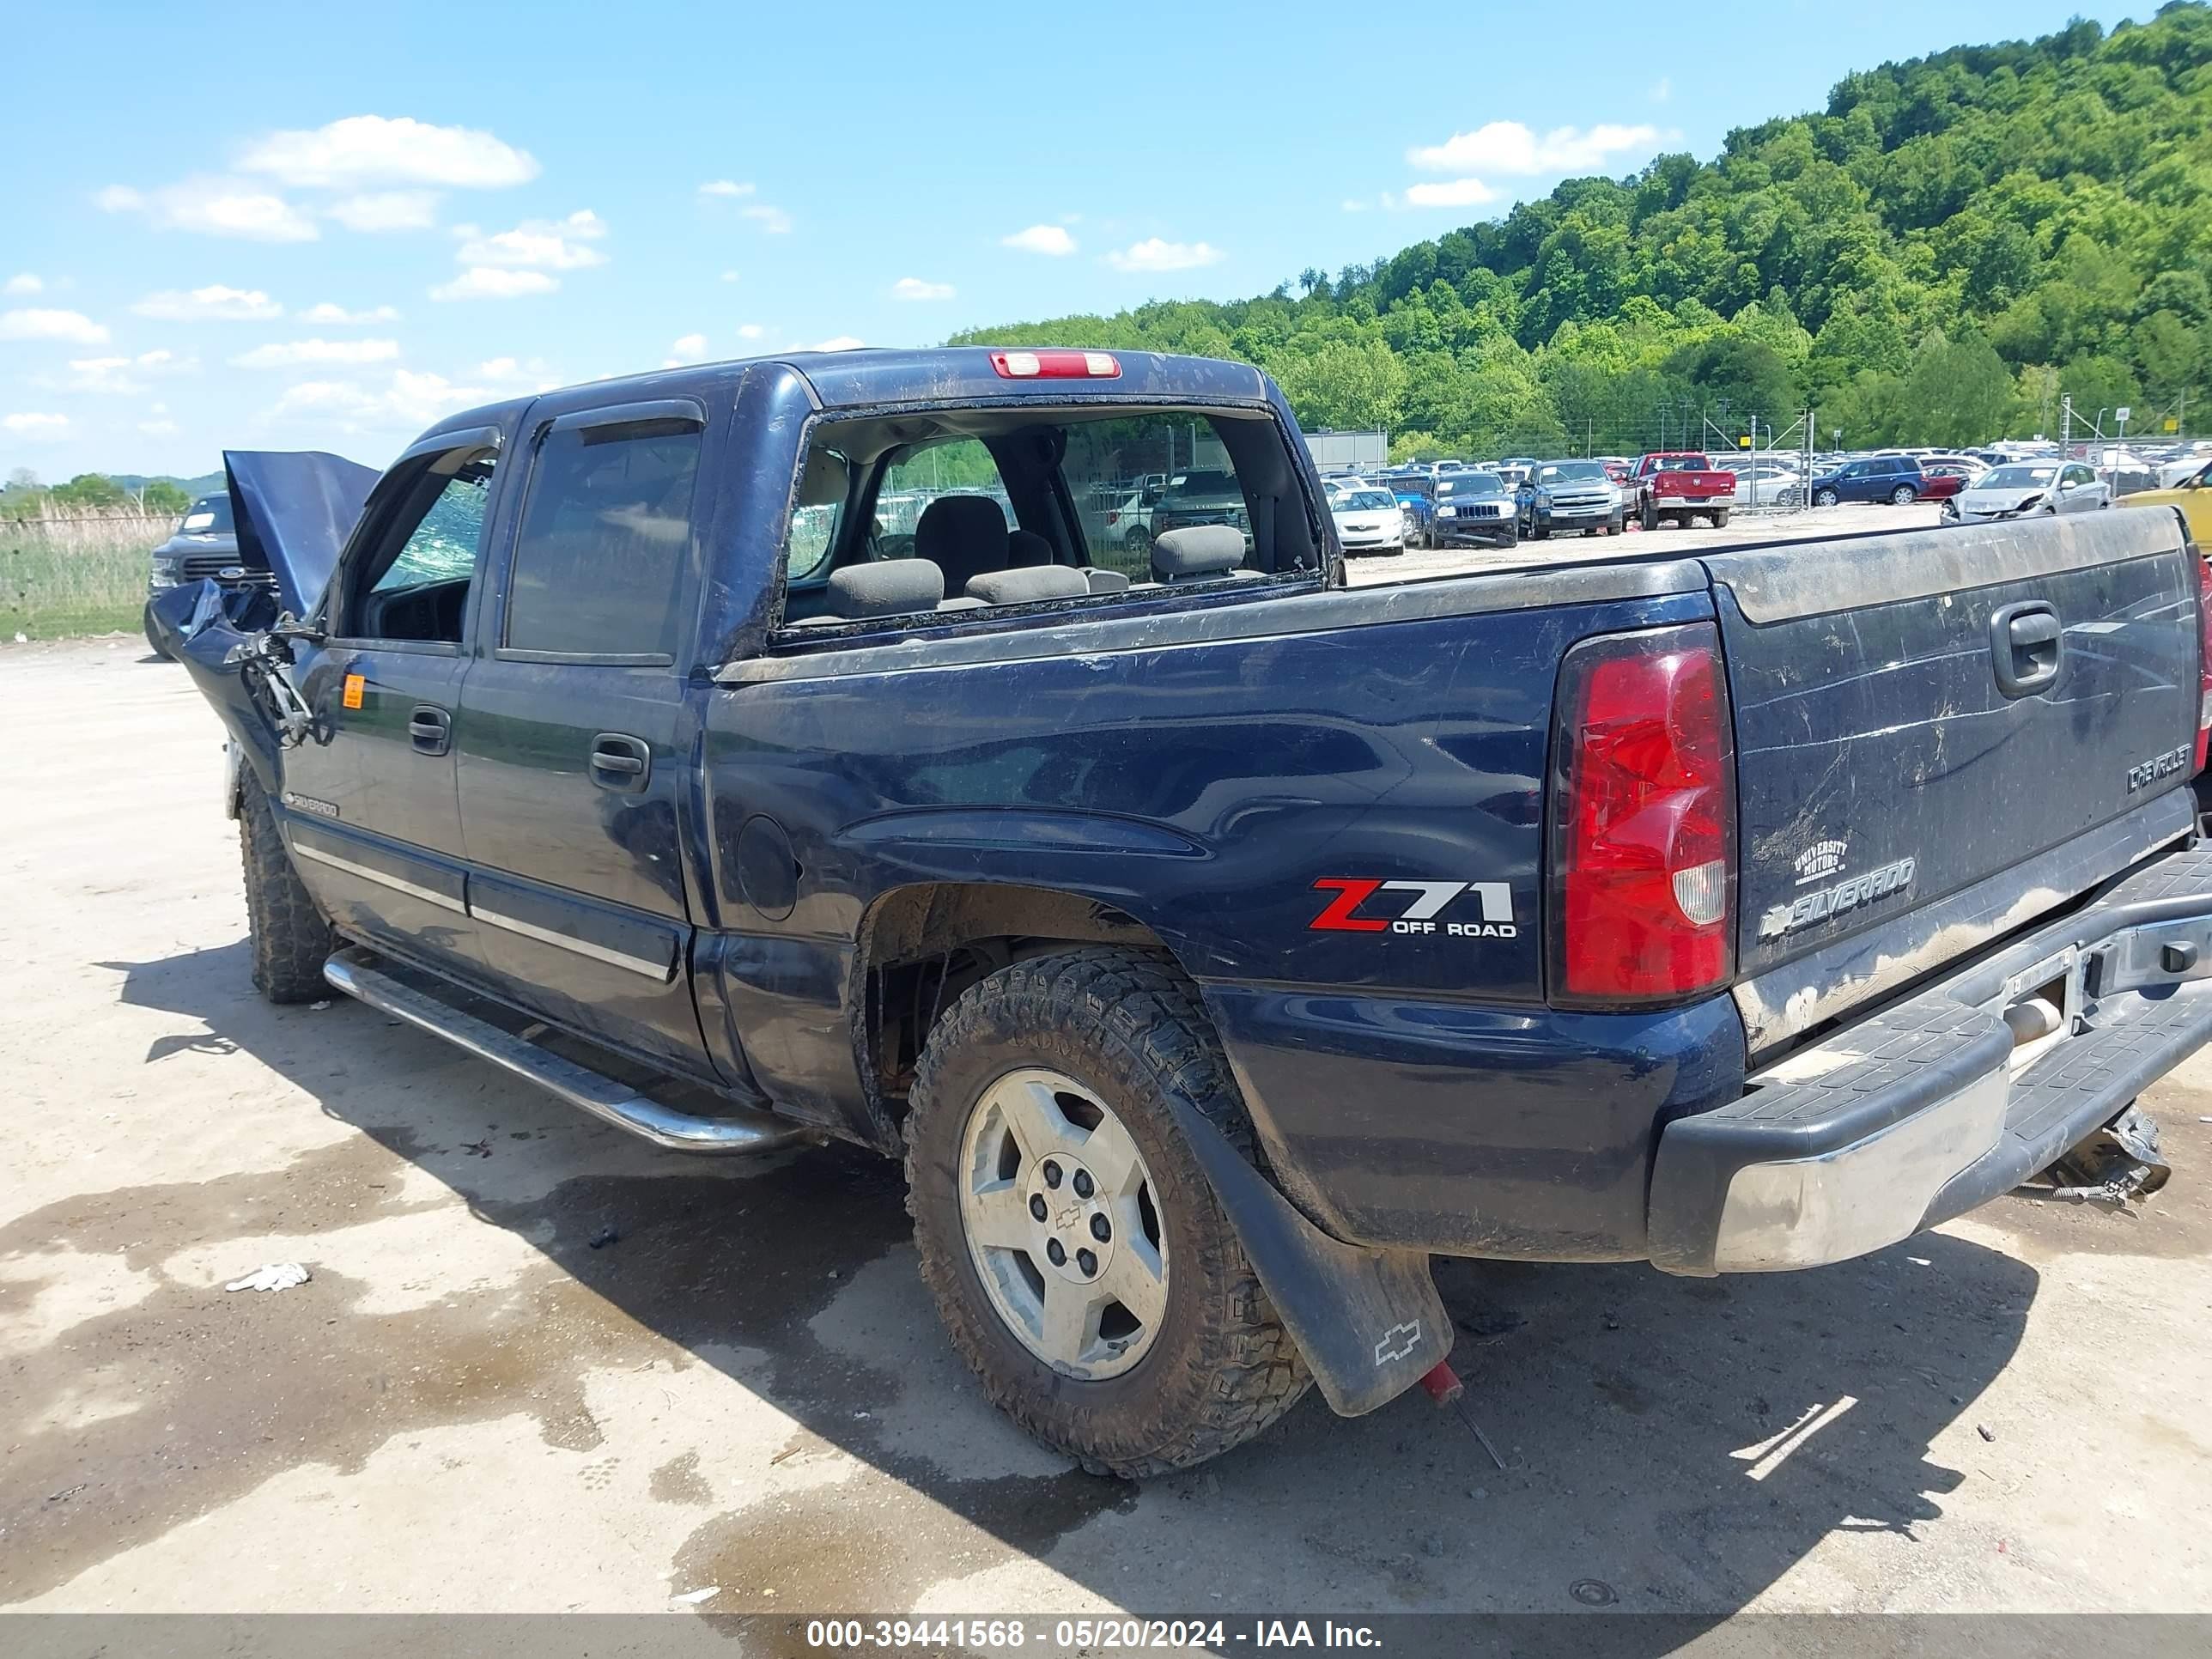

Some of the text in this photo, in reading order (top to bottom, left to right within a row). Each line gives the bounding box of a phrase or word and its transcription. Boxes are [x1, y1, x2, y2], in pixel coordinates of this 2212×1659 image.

[2127, 743, 2192, 793] CHEVROLET
[1795, 840, 1848, 872] UNIVERSITY
[1804, 854, 1838, 876] MOTORS
[1309, 878, 1514, 931] Z71
[1790, 857, 1916, 928] SILVERADO
[1392, 921, 1517, 938] OFF ROAD
